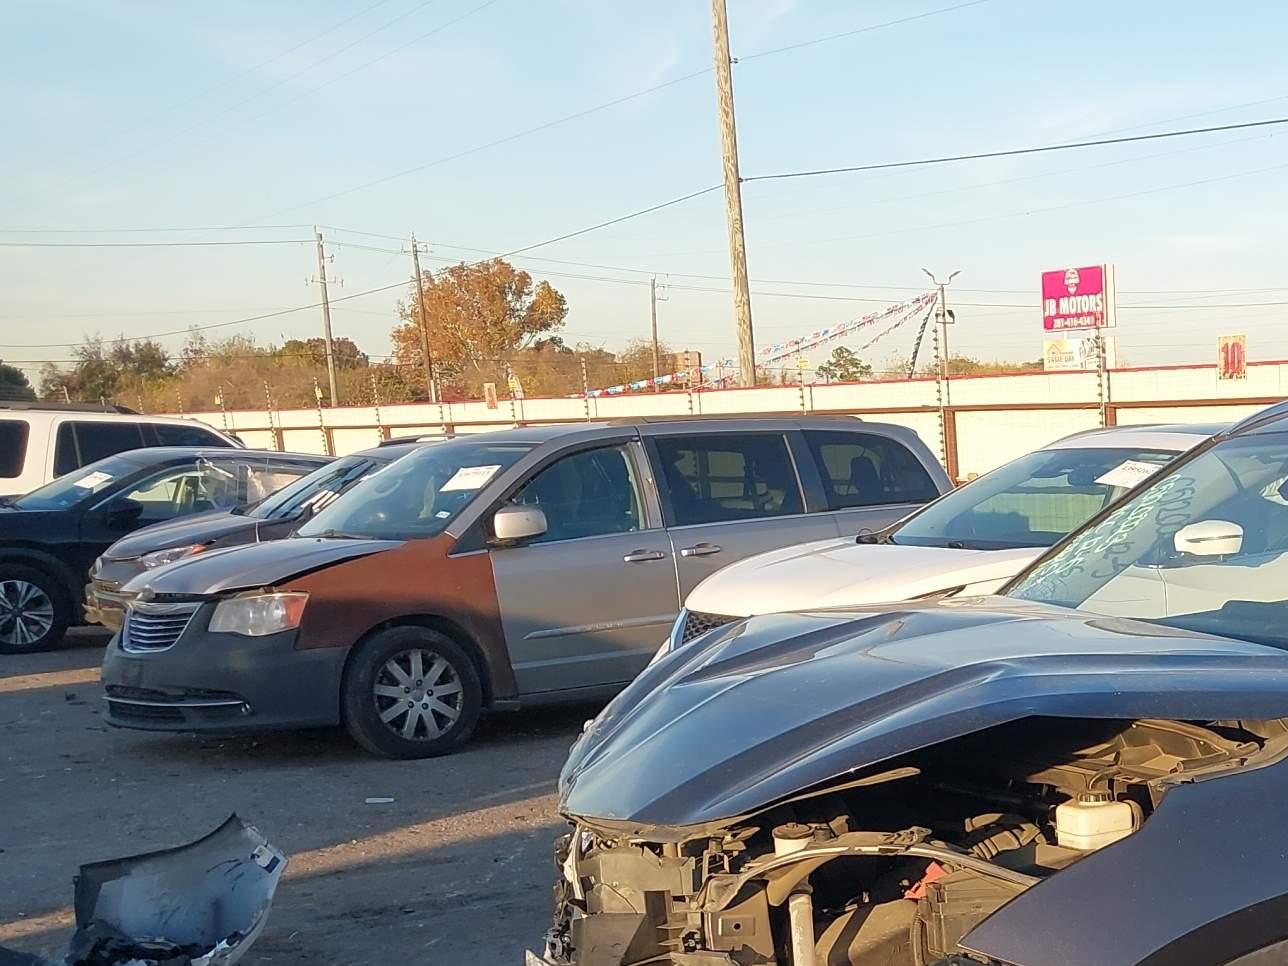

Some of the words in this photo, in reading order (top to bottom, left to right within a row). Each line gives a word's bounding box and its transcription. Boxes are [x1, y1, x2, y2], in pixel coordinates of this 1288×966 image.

[1044, 298, 1056, 317] JB
[1059, 293, 1103, 315] MOTORS
[1221, 342, 1243, 375] 10
